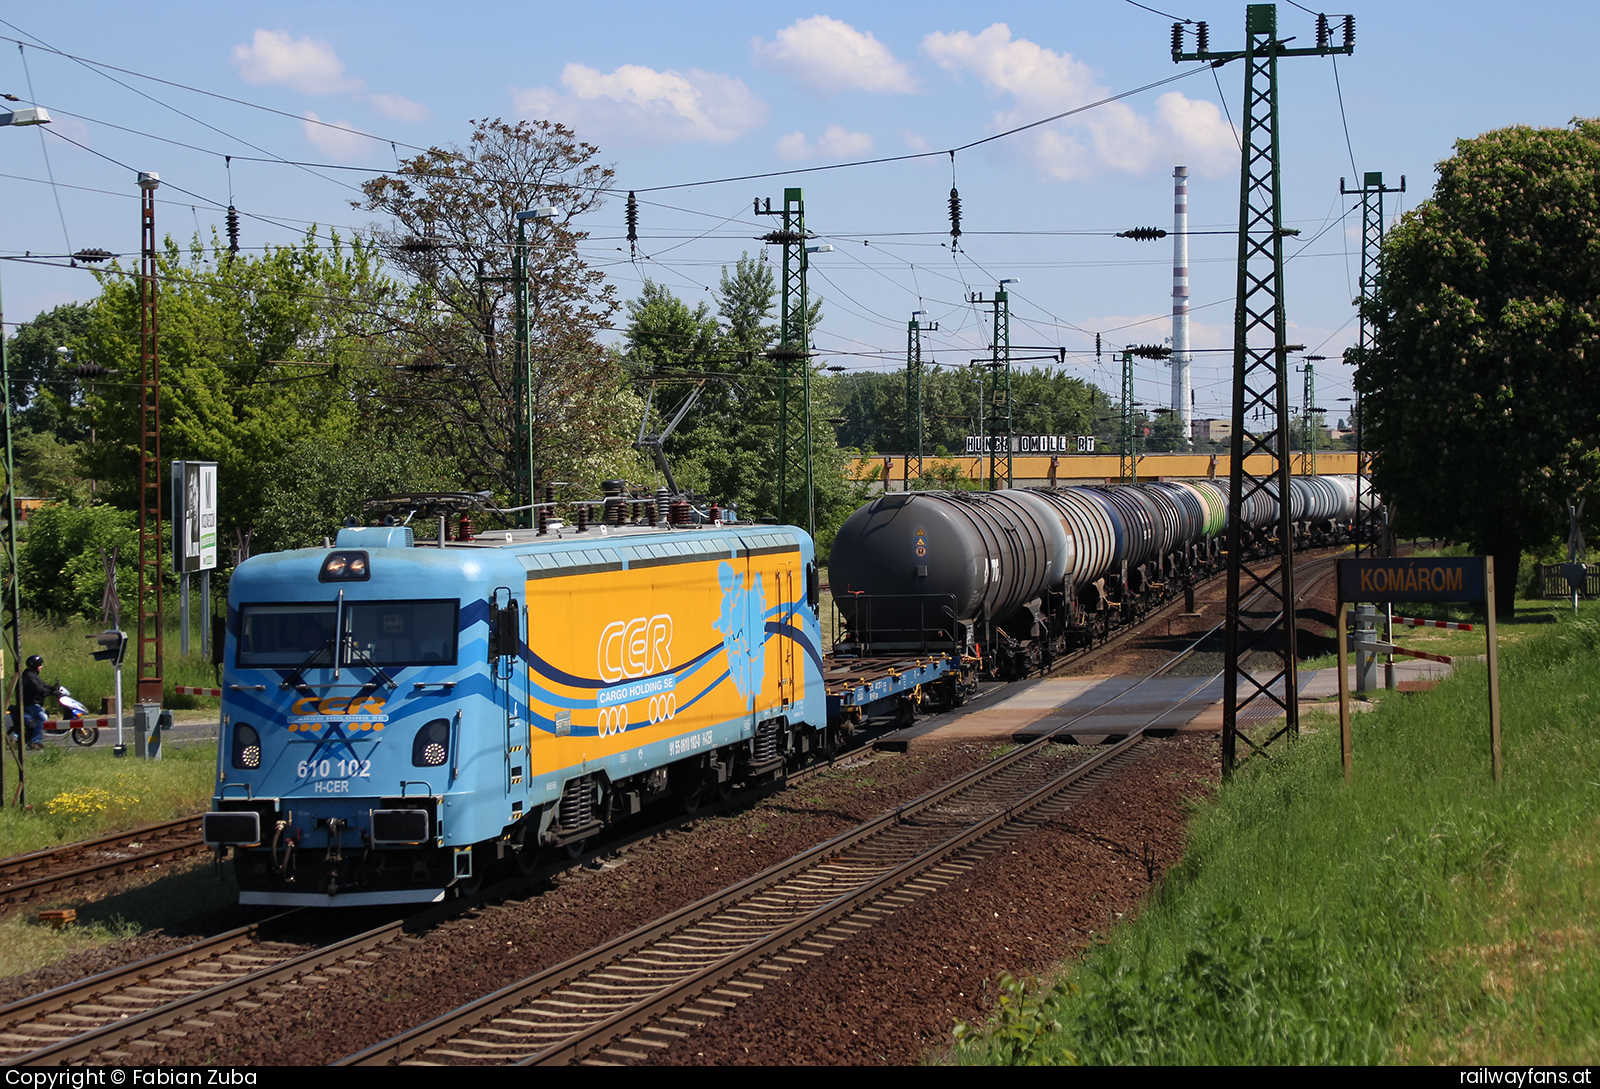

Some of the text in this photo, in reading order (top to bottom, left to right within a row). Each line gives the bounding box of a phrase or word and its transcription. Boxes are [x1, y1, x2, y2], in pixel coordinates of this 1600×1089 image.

[1077, 436, 1095, 452] RT
[1360, 562, 1463, 592] KOMÁROM
[597, 613, 673, 684] CER
[599, 677, 674, 704] CARGO HOLDING SE
[291, 696, 386, 715] CER
[297, 759, 371, 778] 610 102
[314, 780, 349, 793] H-CER
